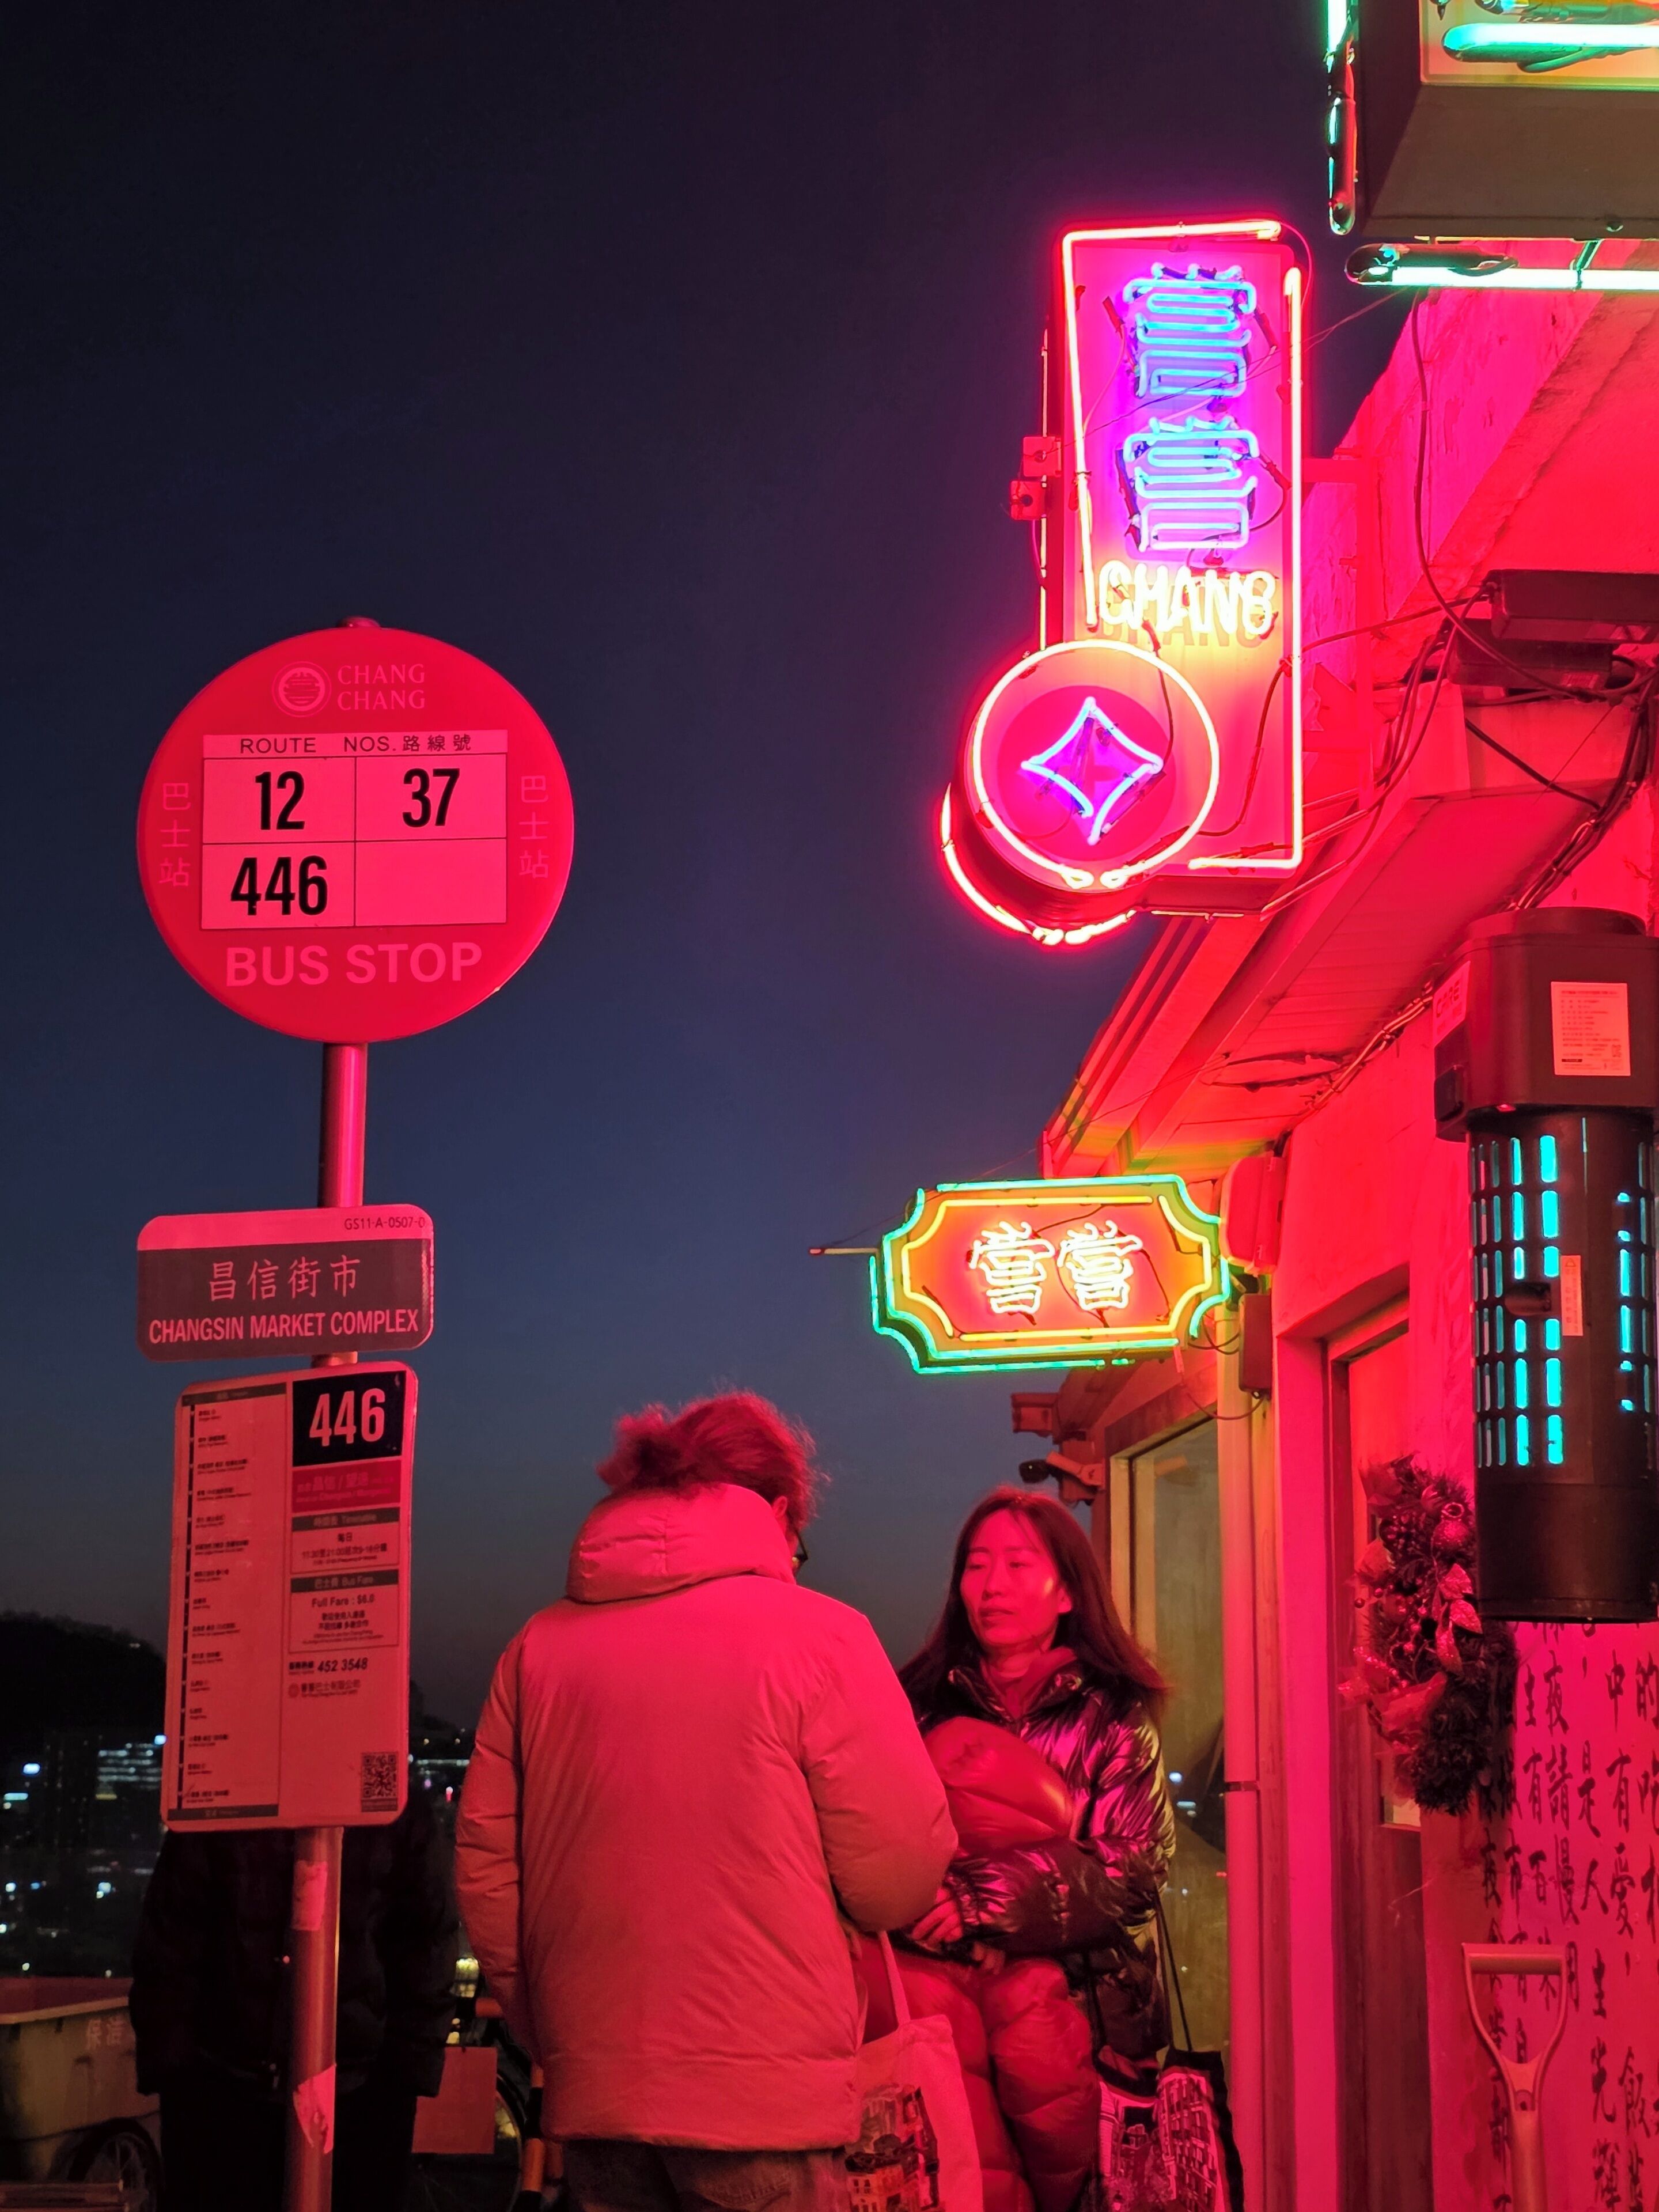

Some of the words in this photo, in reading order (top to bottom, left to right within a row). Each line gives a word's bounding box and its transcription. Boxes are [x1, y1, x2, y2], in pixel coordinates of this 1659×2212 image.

[338, 663, 425, 684] CHANG
[338, 690, 425, 710] CHANG
[240, 737, 317, 754] ROUTE
[343, 736, 397, 752] NOS.
[403, 734, 472, 752] 路線號
[255, 770, 305, 831] 12
[402, 767, 460, 828] 37
[158, 782, 191, 887] 巴士站
[518, 775, 549, 879] 巴士站
[230, 855, 328, 916] 446
[225, 945, 329, 986] BUS
[346, 942, 483, 983] STOP
[209, 1255, 361, 1301] 昌信街市
[149, 1316, 244, 1344] CHANGSIN
[250, 1312, 325, 1339] MARKET
[330, 1308, 419, 1335] COMPLEX
[309, 1388, 386, 1447] 446
[312, 1597, 328, 1608] Full
[330, 1596, 349, 1606] Fare
